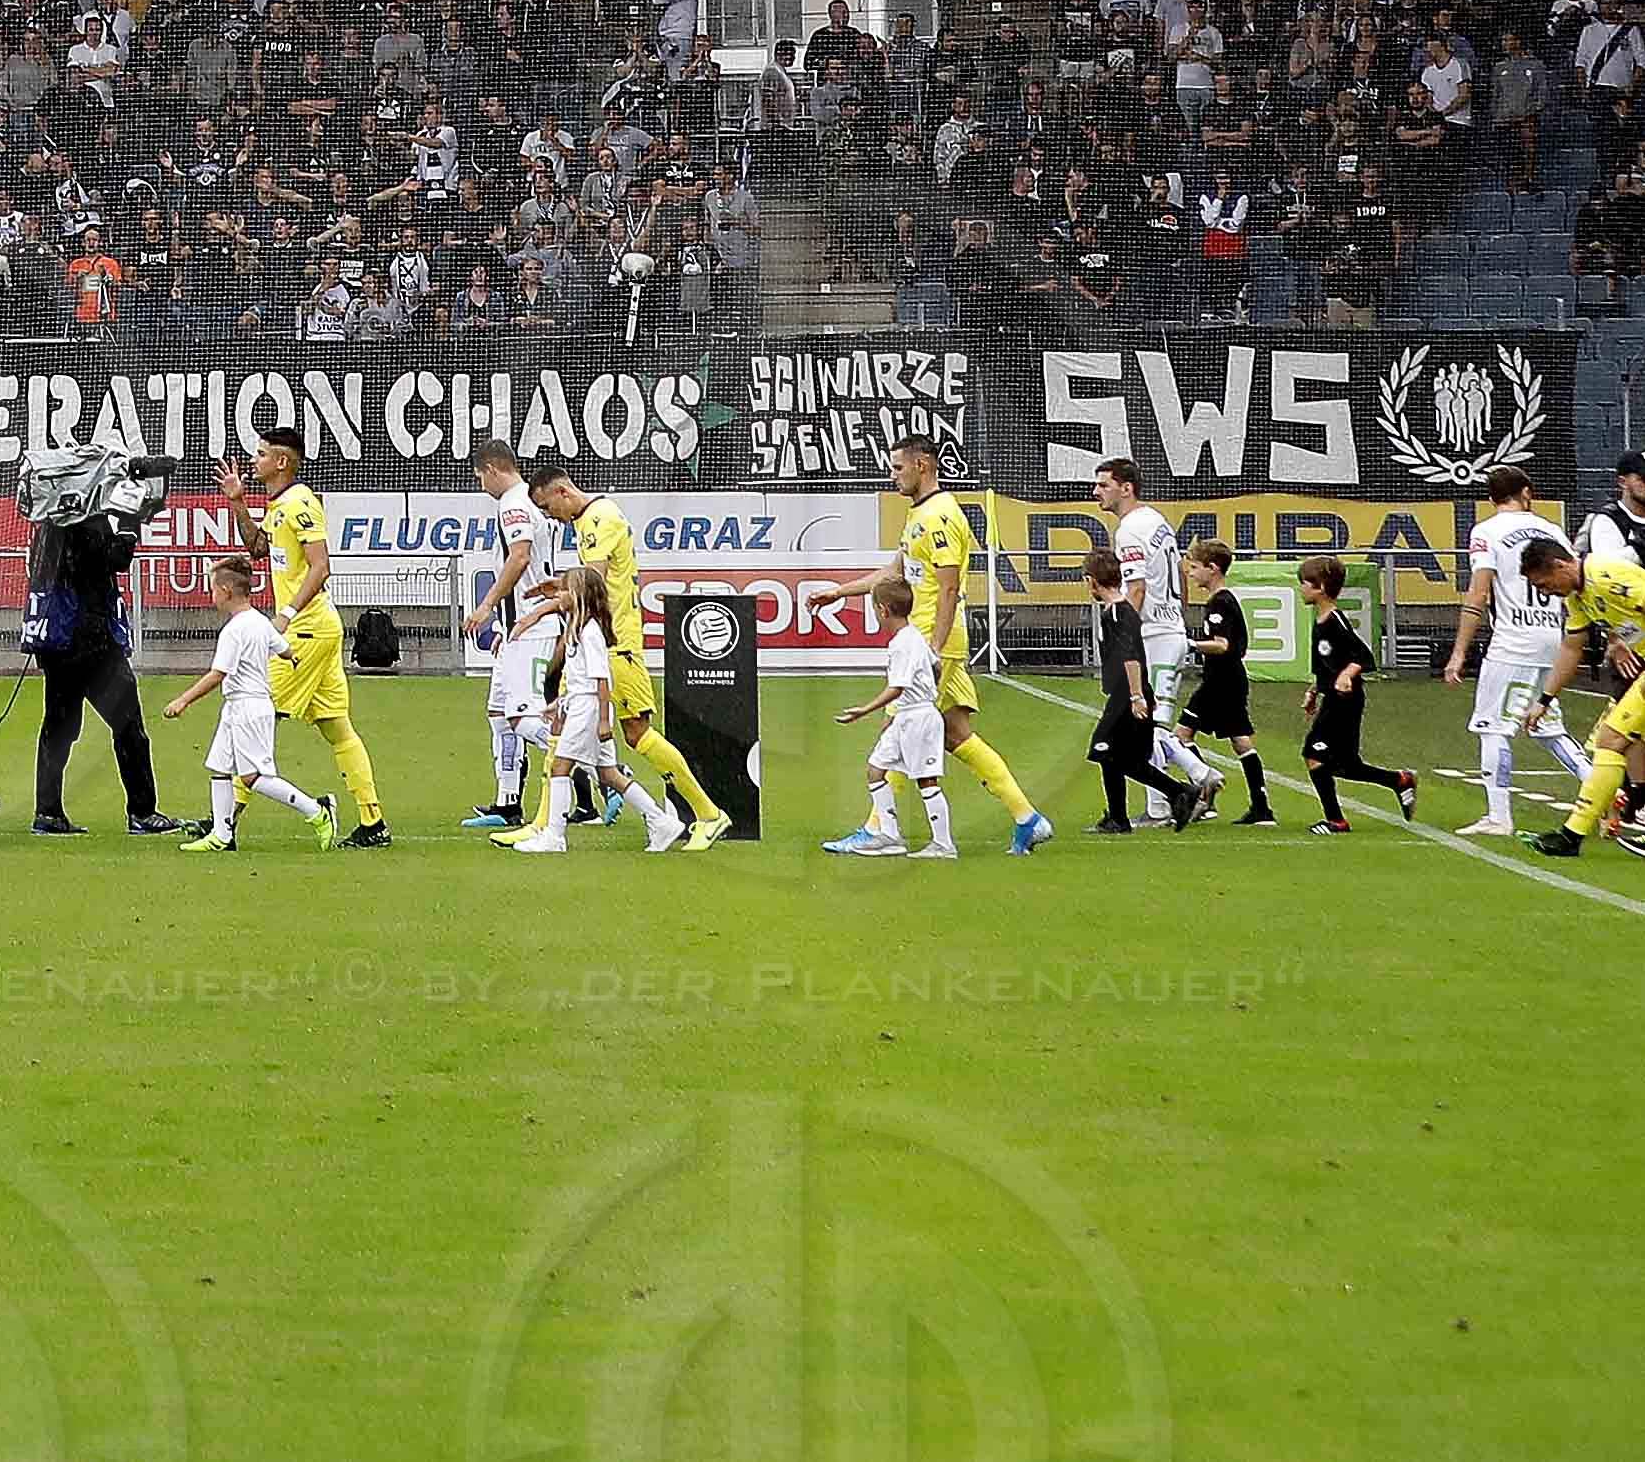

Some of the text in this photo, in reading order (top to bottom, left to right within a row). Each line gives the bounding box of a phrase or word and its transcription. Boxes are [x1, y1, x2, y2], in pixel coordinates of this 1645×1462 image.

[383, 367, 702, 464] CHAOS
[747, 350, 968, 413] SCHWARZE
[1043, 345, 1361, 485] SWS
[643, 515, 777, 551] GRAZ
